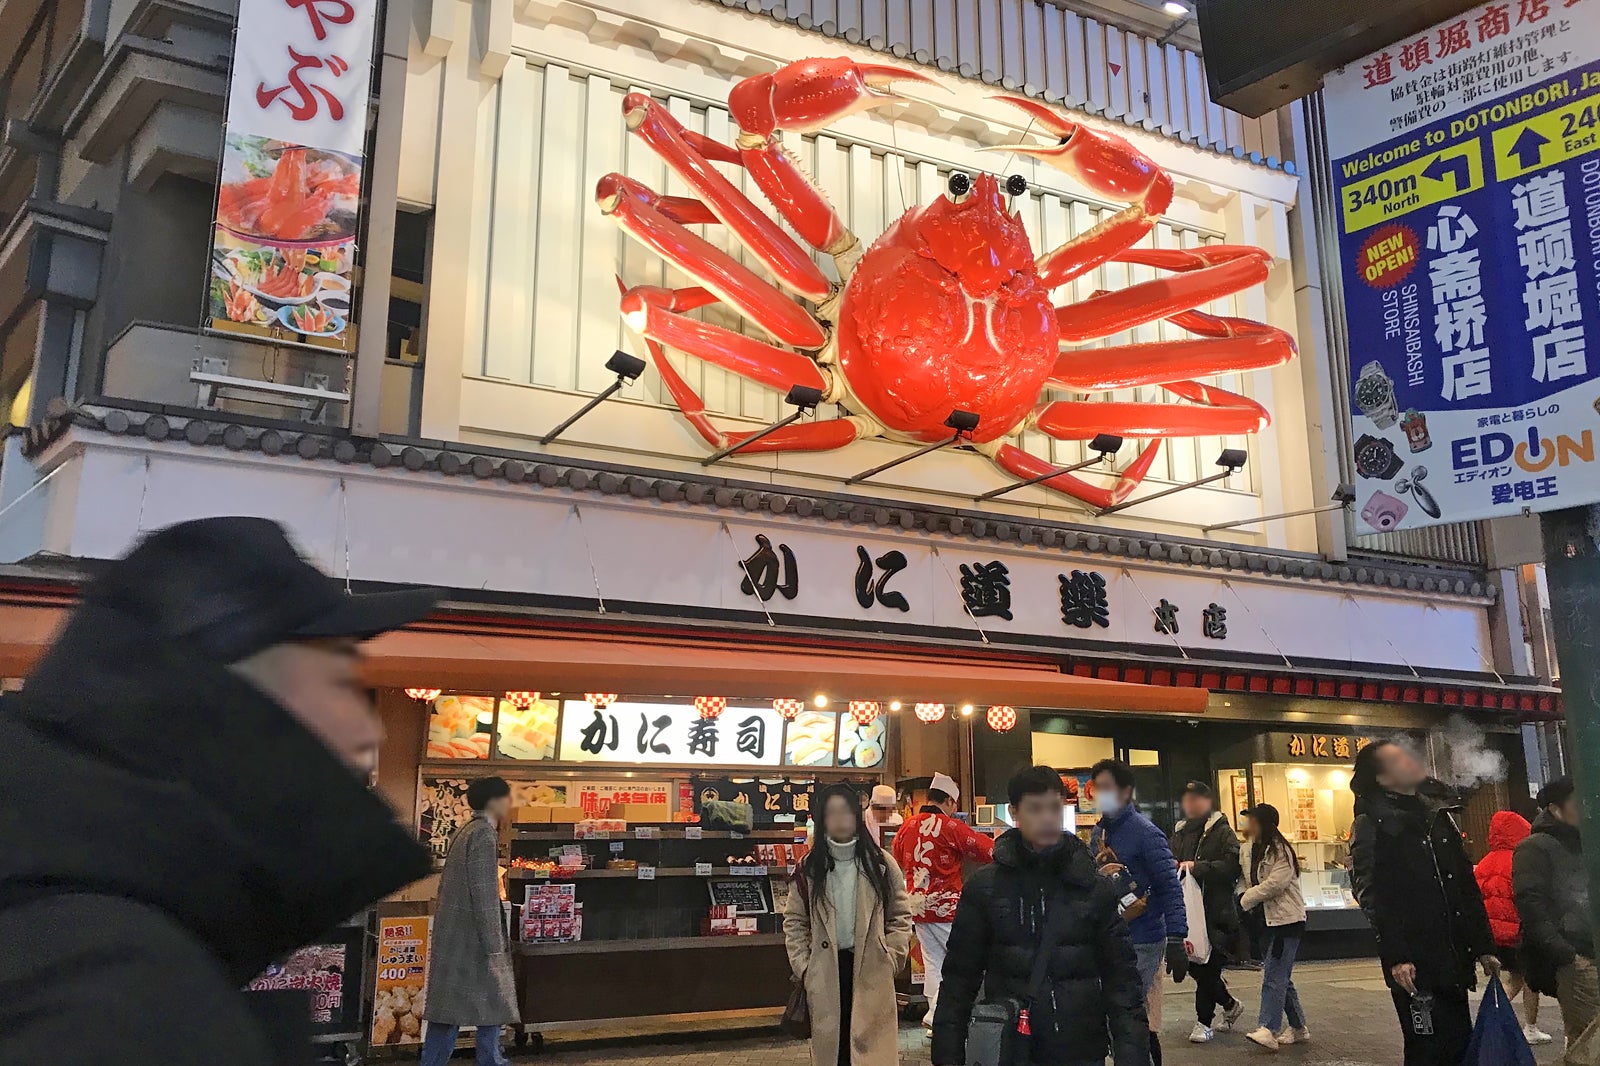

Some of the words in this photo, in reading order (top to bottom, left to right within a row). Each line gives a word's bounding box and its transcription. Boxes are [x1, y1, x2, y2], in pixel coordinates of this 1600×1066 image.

[1362, 0, 1582, 90] 道頓堀商店
[1342, 140, 1421, 179] Welcome
[1425, 128, 1444, 146] to
[1450, 79, 1577, 139] DOTONBORI,
[1564, 132, 1597, 153] East
[1349, 174, 1417, 213] 340m
[1560, 105, 1600, 138] 24
[1383, 193, 1420, 215] North
[1365, 245, 1415, 281] OPEN!
[1366, 231, 1404, 263] NEW
[1382, 290, 1401, 340] STORE
[1401, 283, 1425, 387] SHINSAIBASHI
[1477, 403, 1560, 428] 家電と暮らしの
[1451, 426, 1595, 472] EDION
[1454, 466, 1513, 484] エディオン
[580, 710, 766, 759] かに寿司
[381, 954, 424, 965] しゅうまい
